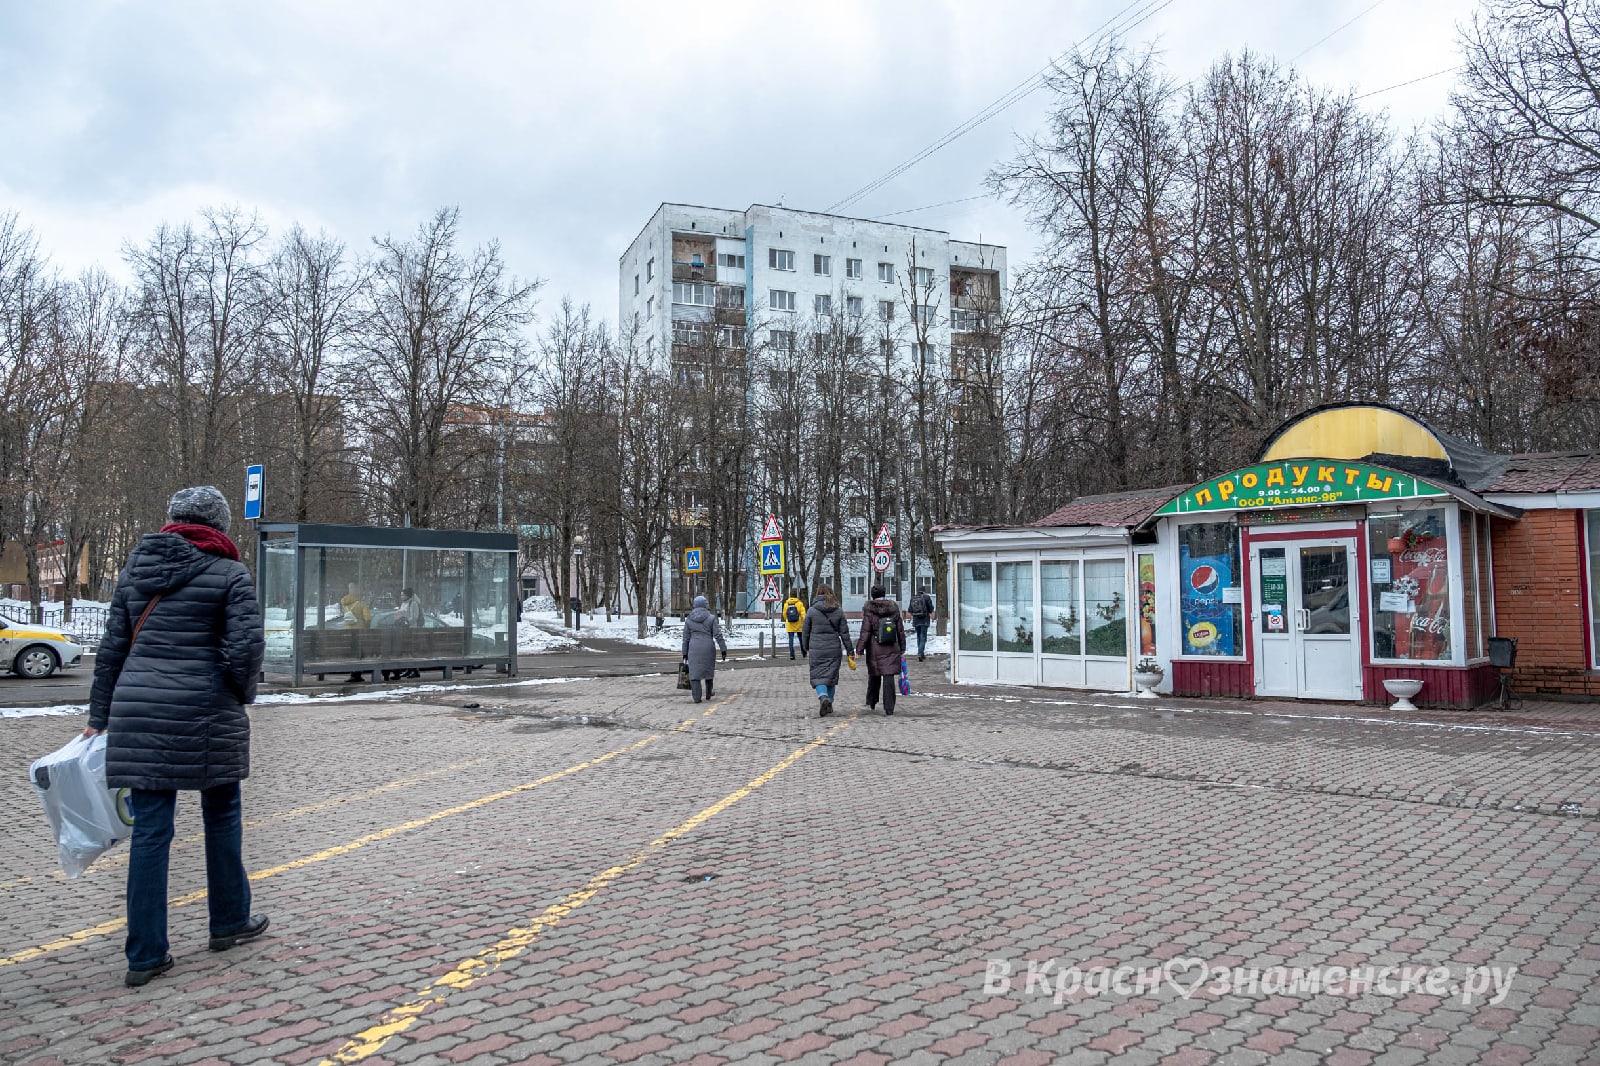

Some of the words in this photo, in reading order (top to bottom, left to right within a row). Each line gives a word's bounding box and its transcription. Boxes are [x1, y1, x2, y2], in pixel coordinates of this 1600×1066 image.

[1290, 486, 1320, 494] 24.00
[1238, 498, 1265, 507] ООО
[877, 555, 888, 565] 40
